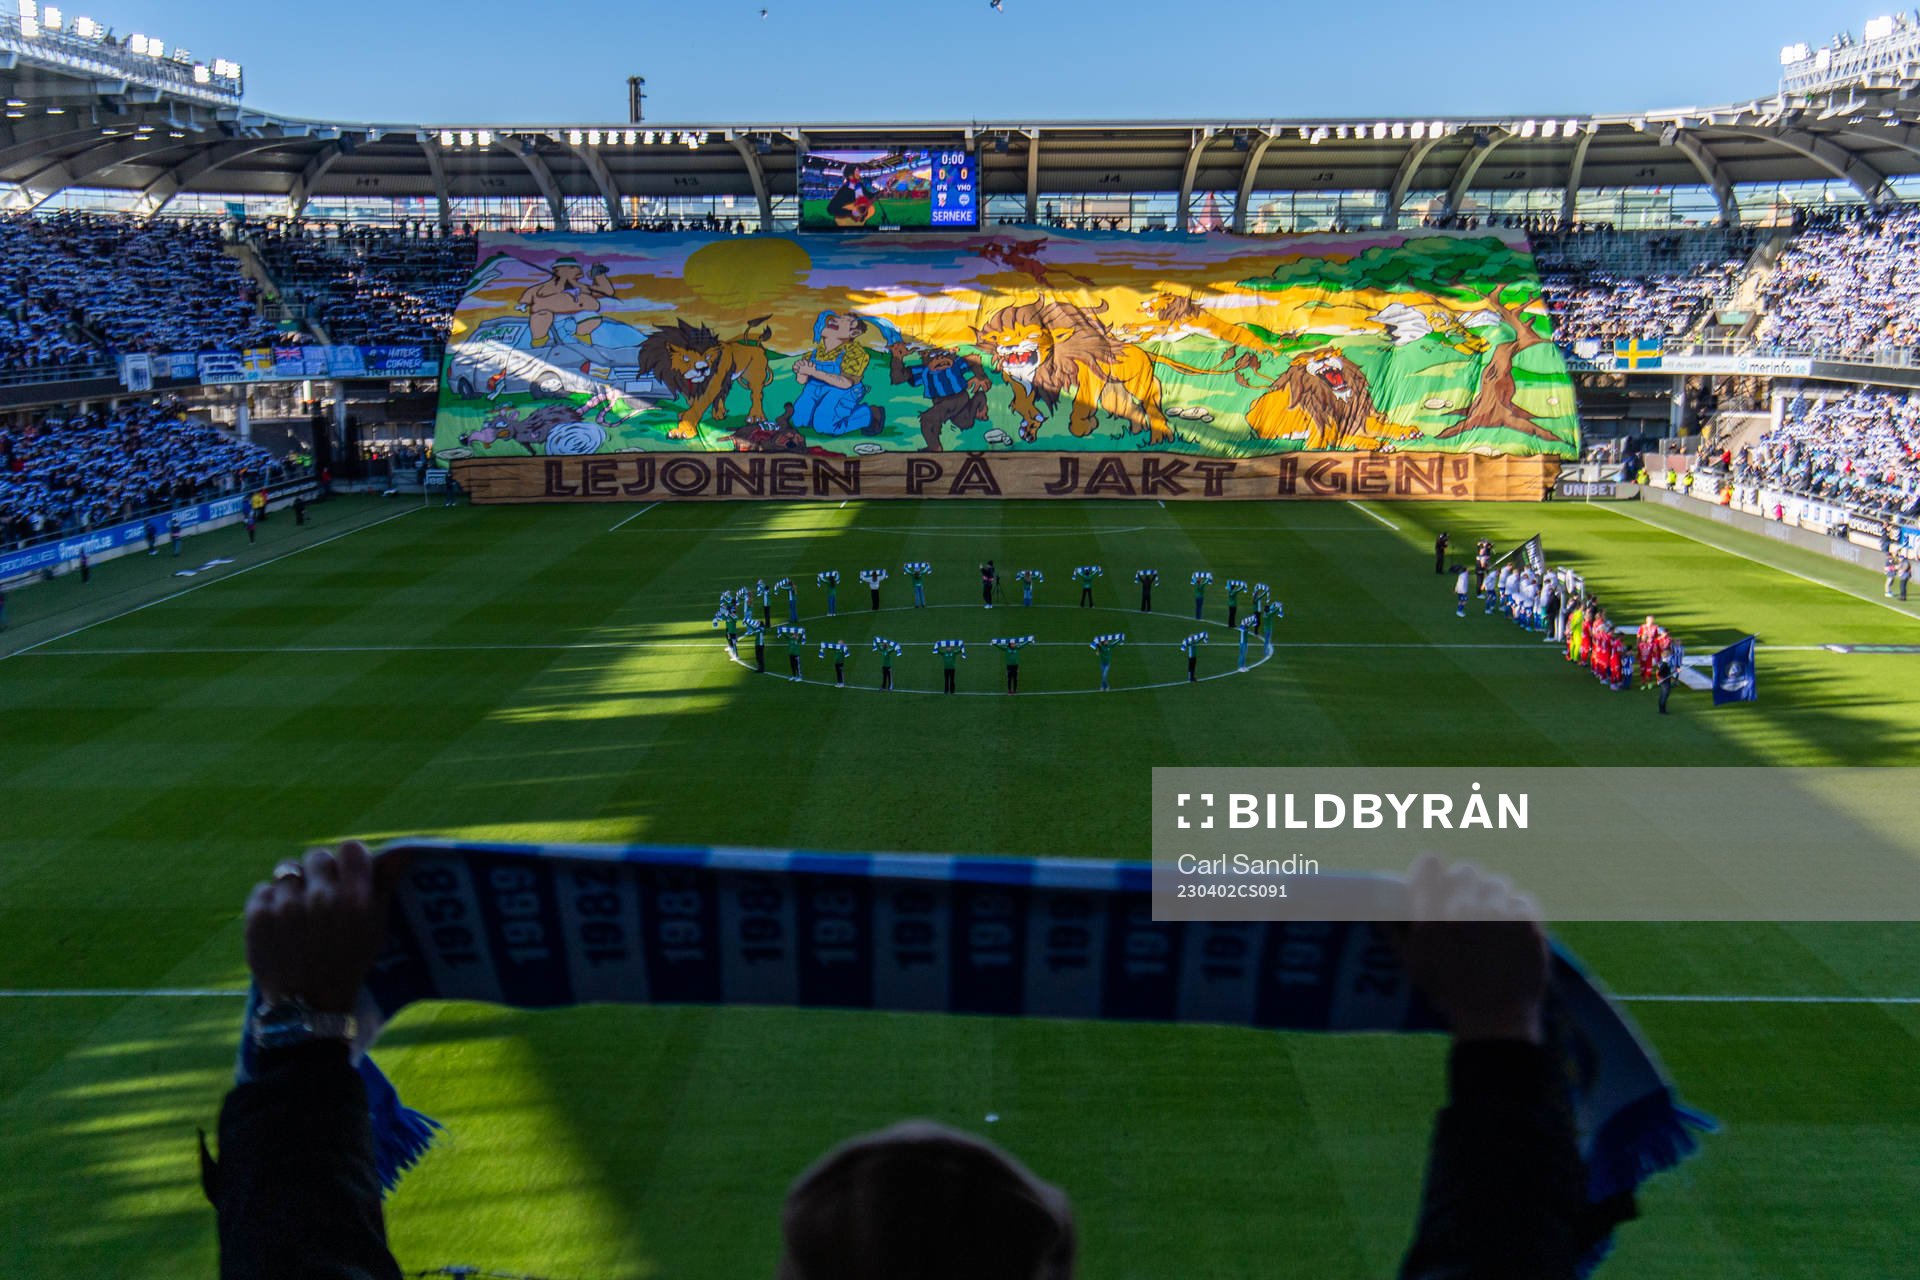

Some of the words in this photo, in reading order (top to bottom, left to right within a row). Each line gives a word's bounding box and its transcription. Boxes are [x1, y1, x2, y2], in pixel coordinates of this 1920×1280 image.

[942, 153, 964, 165] 0:00
[939, 169, 946, 180] 0
[960, 167, 968, 180] 0
[932, 211, 972, 222] SERNEKE
[386, 359, 421, 369] CORNER
[1567, 357, 1614, 371] merinf
[545, 458, 861, 497] LEJONEN
[906, 453, 1002, 497] PÅ
[1045, 457, 1238, 497] JAKT
[1279, 456, 1470, 497] IGEN!
[1563, 483, 1616, 496] UNIBET
[412, 867, 478, 968] 1958
[490, 864, 550, 964] 1969
